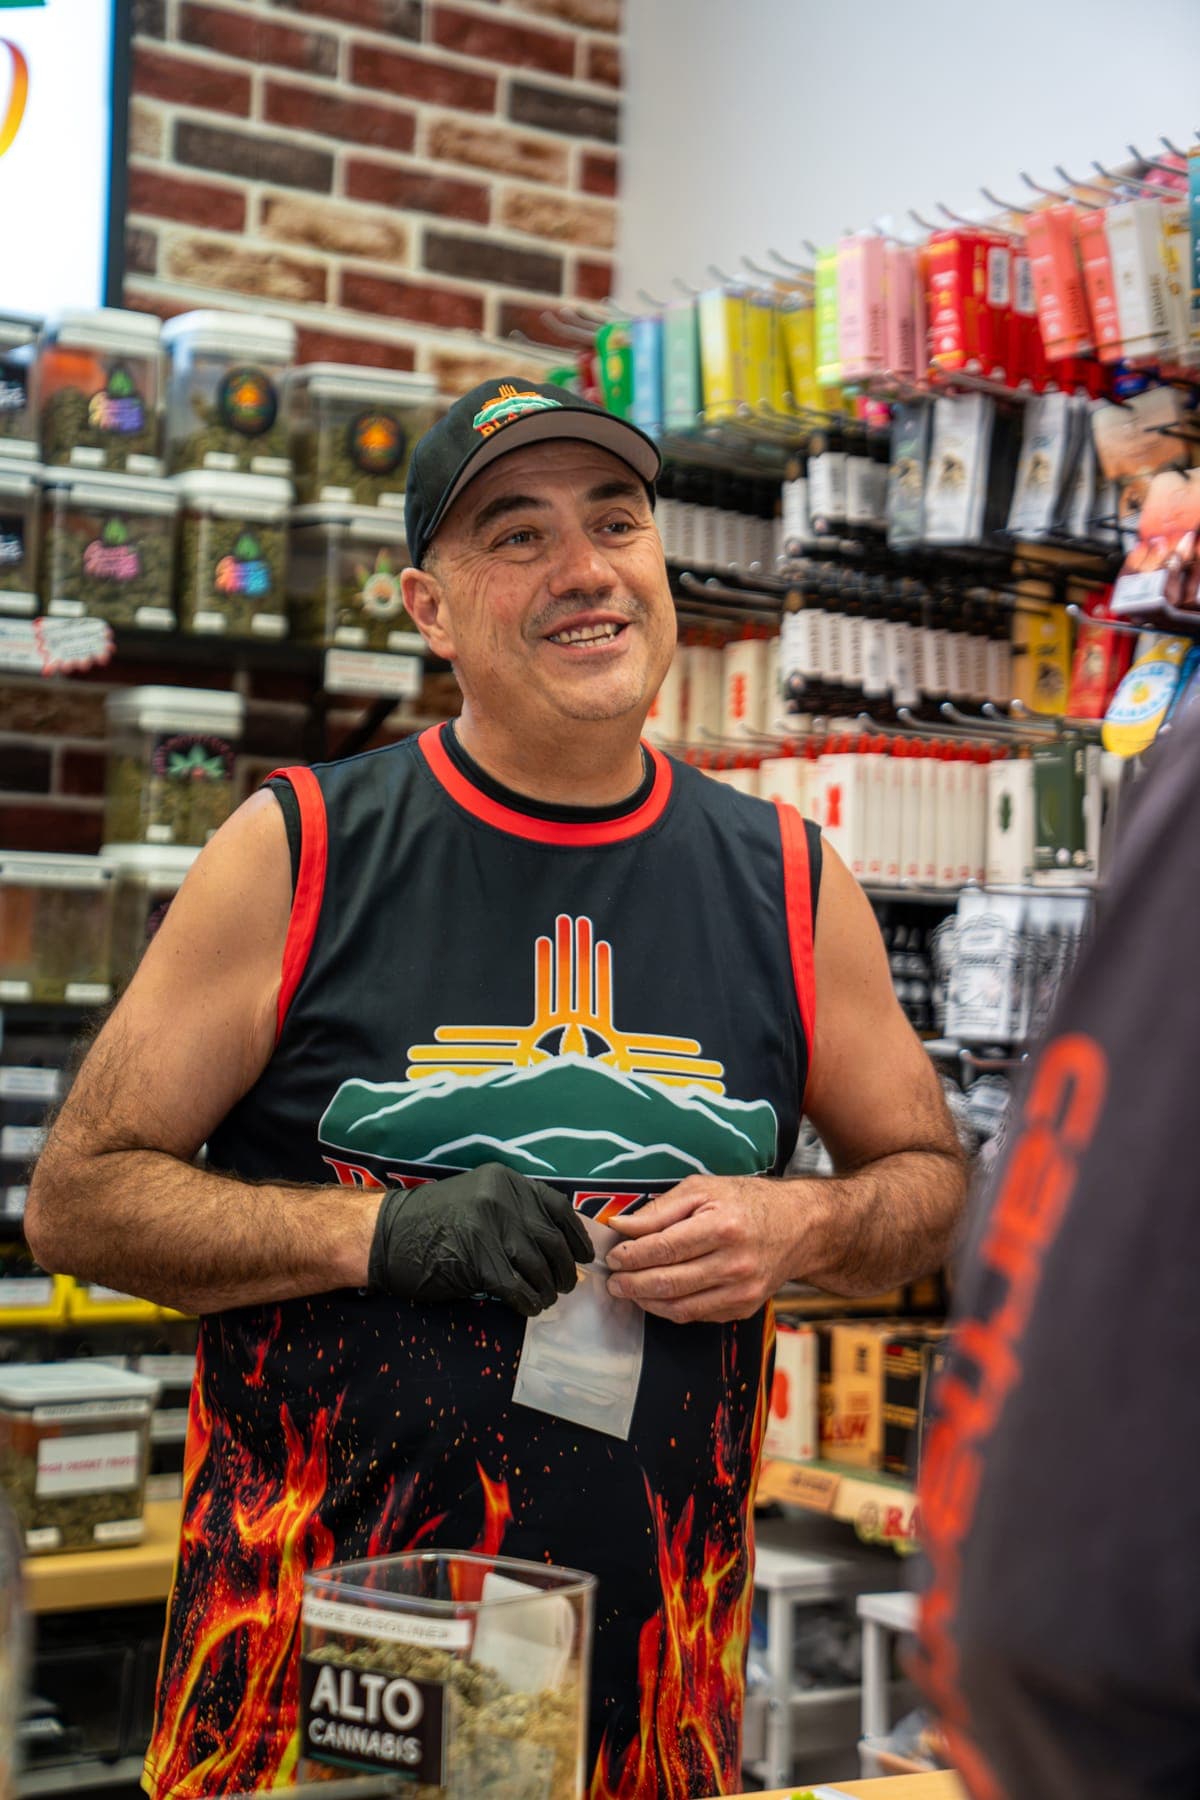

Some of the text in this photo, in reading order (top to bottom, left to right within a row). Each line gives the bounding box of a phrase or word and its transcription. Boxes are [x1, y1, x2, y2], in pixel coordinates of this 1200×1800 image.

[882, 1503, 927, 1537] RA
[309, 1664, 425, 1731] ALTO
[307, 1717, 422, 1765] CANNABIS
